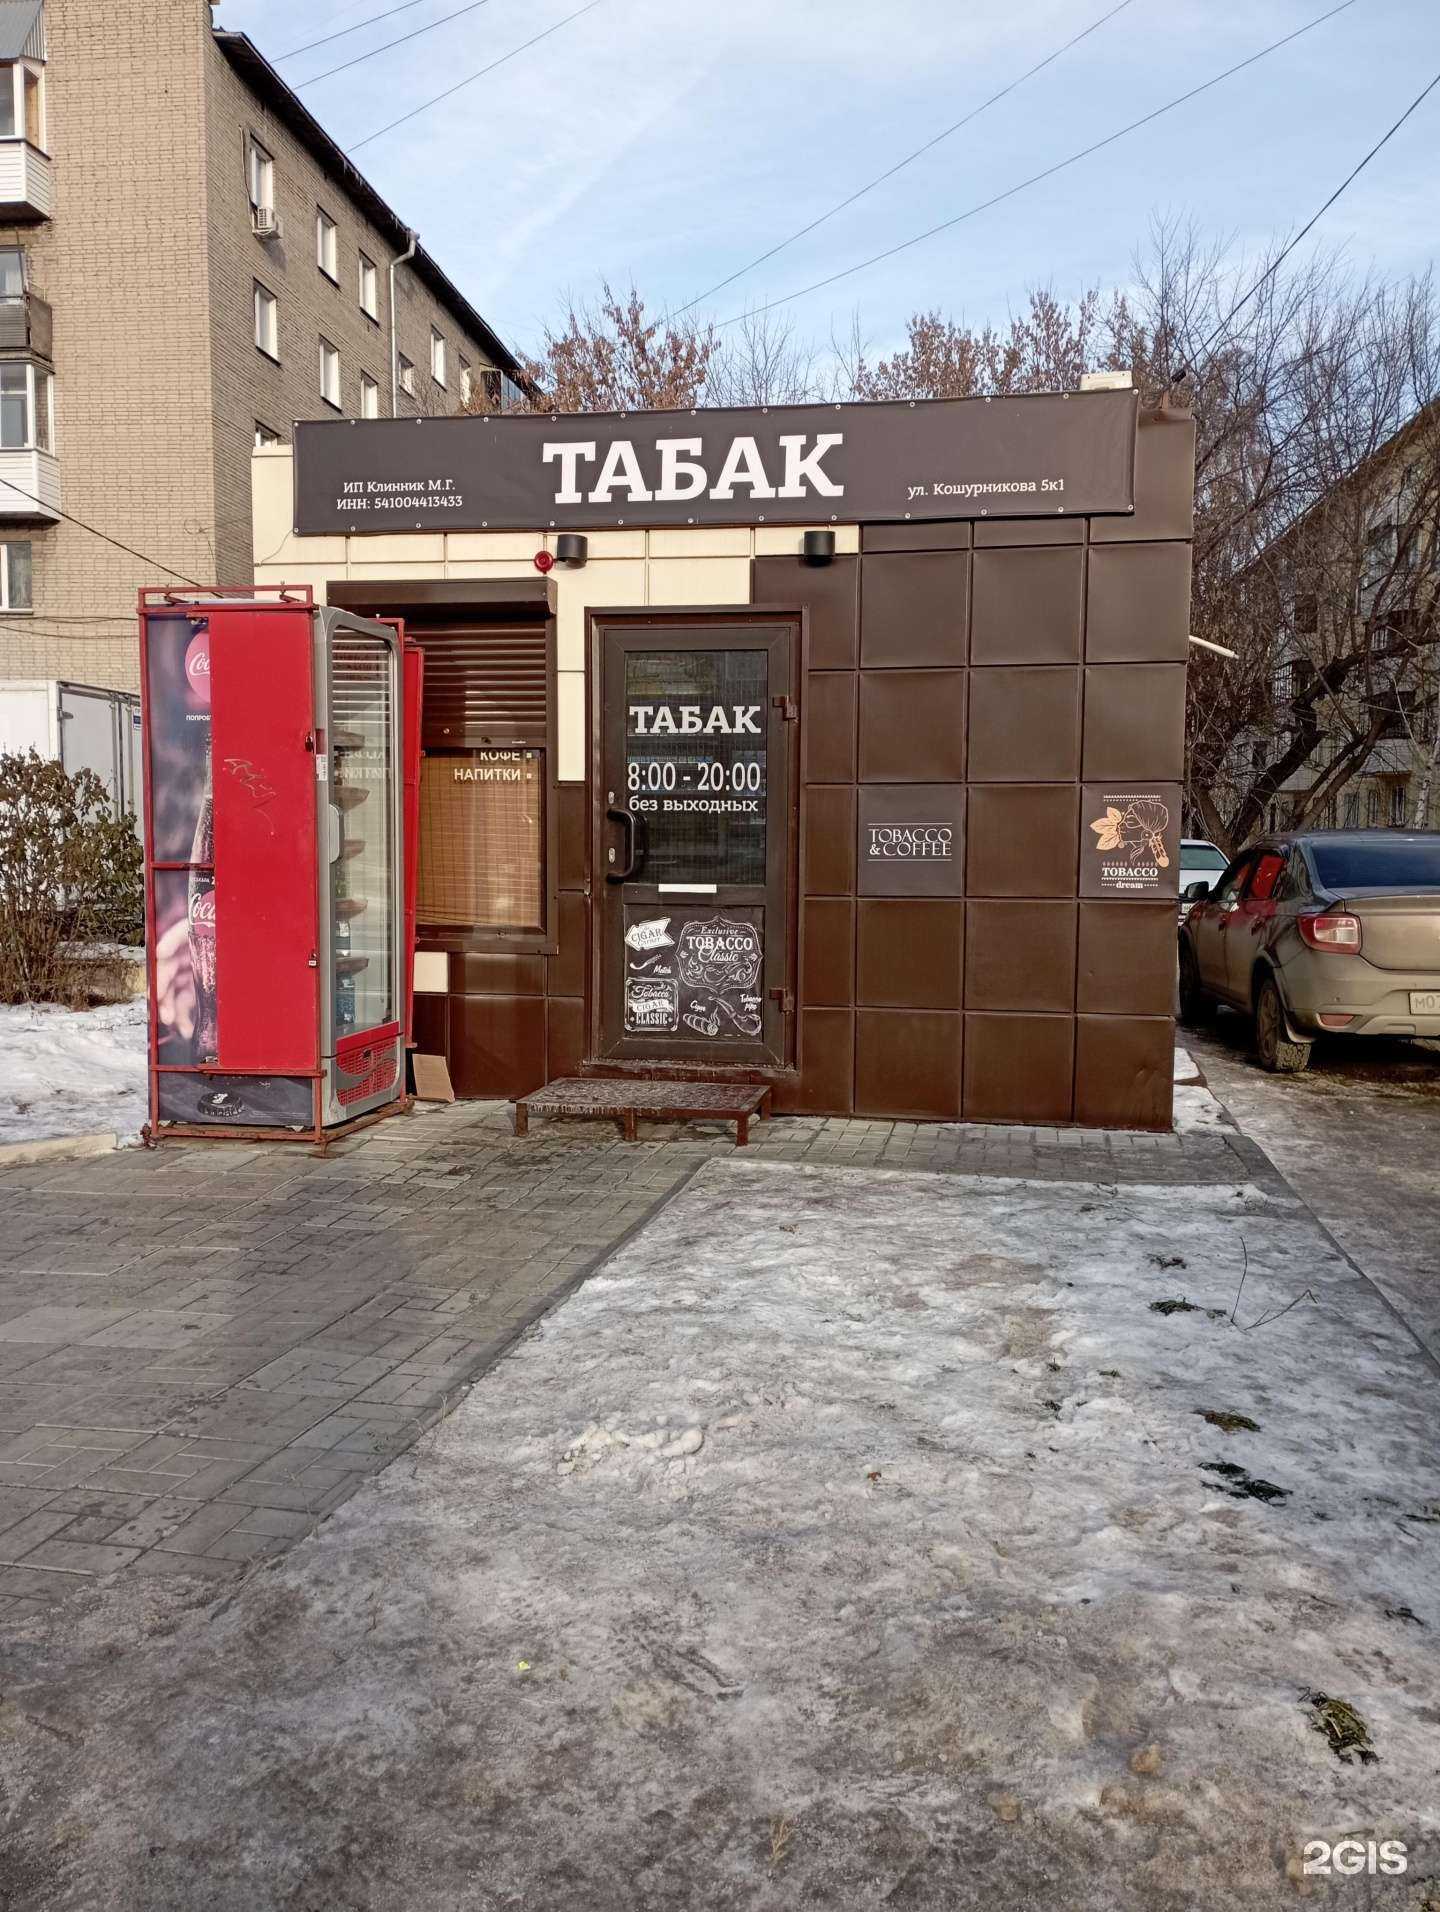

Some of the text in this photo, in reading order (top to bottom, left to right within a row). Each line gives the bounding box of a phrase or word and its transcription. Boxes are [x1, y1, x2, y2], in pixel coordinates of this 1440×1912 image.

[542, 432, 845, 504] ТАБАК
[343, 479, 456, 493] ИП Клинник М.Г.
[907, 478, 1065, 500] ул. Кошурникова 5к1
[336, 495, 463, 510] ИНН: 541004413433
[629, 705, 762, 734] ТАБАК
[480, 751, 521, 761] КОФЕ
[454, 768, 521, 781] НАПИТКИ
[627, 762, 676, 791] 8:00
[697, 762, 761, 791] 20:00
[629, 795, 758, 814] без выходных
[868, 828, 952, 843] TOBACCO
[1101, 867, 1159, 877] TOBACCO
[1116, 880, 1144, 889] dream
[700, 926, 739, 935] Exclusive
[686, 936, 753, 951] TOBACCO
[698, 948, 739, 962] Classic
[631, 984, 670, 999] Tobacco
[636, 1012, 668, 1025] CLASSIC
